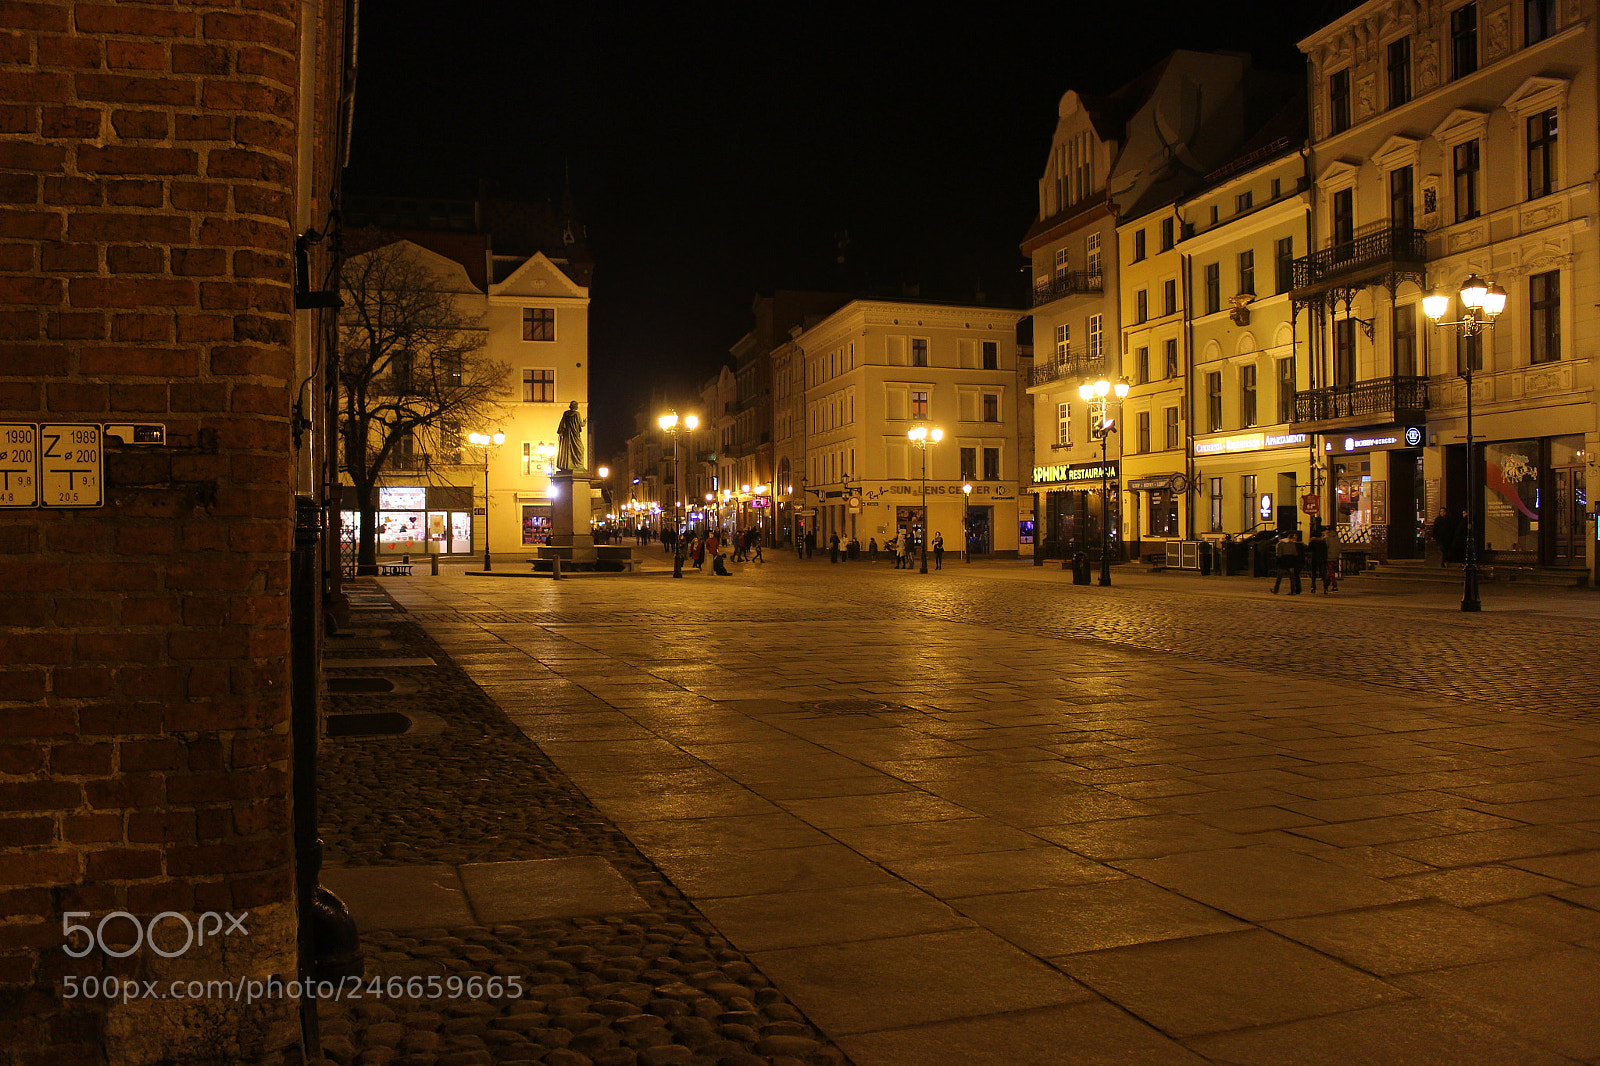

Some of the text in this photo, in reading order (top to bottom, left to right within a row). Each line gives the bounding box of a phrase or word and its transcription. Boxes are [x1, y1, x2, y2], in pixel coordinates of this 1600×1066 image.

[5, 430, 32, 443] 1990
[70, 430, 97, 444] 1989
[43, 434, 61, 457] Z
[11, 449, 33, 463] 200
[76, 449, 97, 463] 200
[1033, 465, 1067, 482] SPHINX
[890, 486, 912, 495] SUN
[948, 486, 990, 495] CETER
